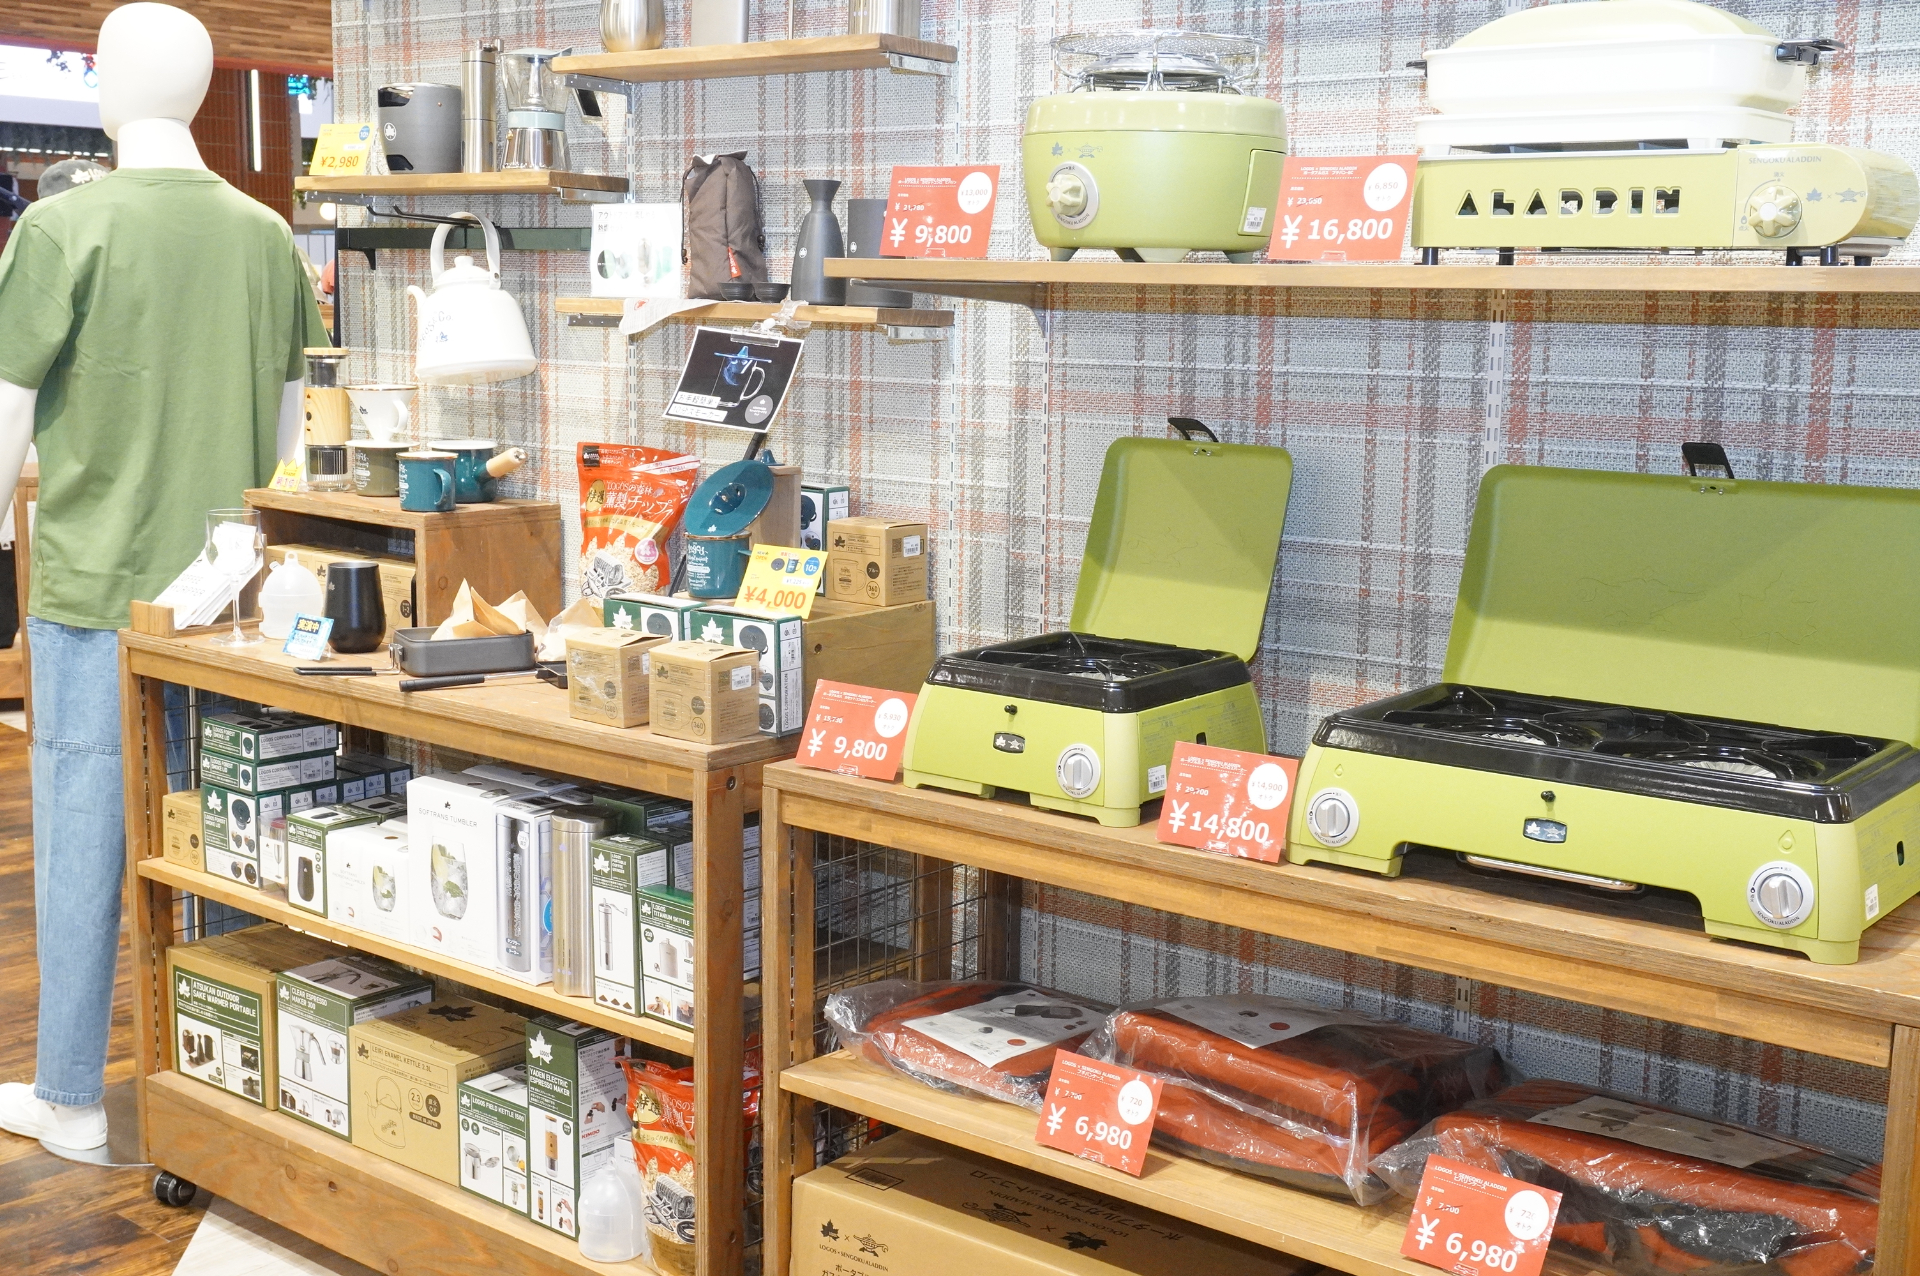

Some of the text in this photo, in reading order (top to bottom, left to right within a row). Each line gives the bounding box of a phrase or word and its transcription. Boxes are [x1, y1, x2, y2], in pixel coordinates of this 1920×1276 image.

[321, 155, 359, 170] ¥2,980
[1455, 187, 1682, 218] ALADDIN
[890, 218, 972, 248] ¥ 9,800
[1281, 214, 1303, 248] ¥
[1308, 218, 1394, 244] 16,800
[588, 490, 604, 505] 特選
[744, 586, 806, 610] ¥4,000
[808, 728, 888, 760] ¥ 9,800
[272, 764, 299, 772] CORPORATION
[418, 808, 478, 828] SOFTRANS TUMBLER
[652, 904, 666, 913] LOGOS
[654, 911, 690, 926] TITANIUM SKITTLE
[193, 981, 240, 1004] ATSUKAN OUTDOOR
[292, 987, 328, 1006] CLEAR ESPRESSO
[292, 994, 306, 1007] MAKER
[192, 990, 206, 1000] SAKE
[206, 994, 229, 1008] WARMER
[229, 1002, 256, 1018] PORTABLE
[384, 1051, 402, 1062] ENAMEL
[403, 1056, 420, 1068] KETTLE
[540, 1050, 550, 1058] LOGOS
[1062, 1060, 1076, 1068] LOGOS
[529, 1068, 568, 1088] YADEN ELECTRIC
[530, 1076, 553, 1090] ESPRESSO
[553, 1084, 570, 1096] MAKER
[411, 1092, 420, 1103] 2.3
[1054, 1087, 1060, 1096] ¥
[1130, 1096, 1142, 1106] 720
[472, 1096, 485, 1108] LOGOS
[486, 1102, 498, 1112] FIELD
[498, 1106, 514, 1118] KETTLE
[514, 1112, 524, 1122] 1500
[412, 1114, 422, 1122] MADE
[426, 1118, 438, 1128] JAPAN
[1046, 1102, 1132, 1150] ¥ 6,980
[1434, 1165, 1452, 1175] LOGOS
[1458, 1172, 1484, 1185] SENGOKU
[1426, 1196, 1433, 1206] ¥
[1415, 1214, 1518, 1272] ¥ 6,980
[819, 1244, 888, 1272] LOGOS SENGOKU ALADDIN
